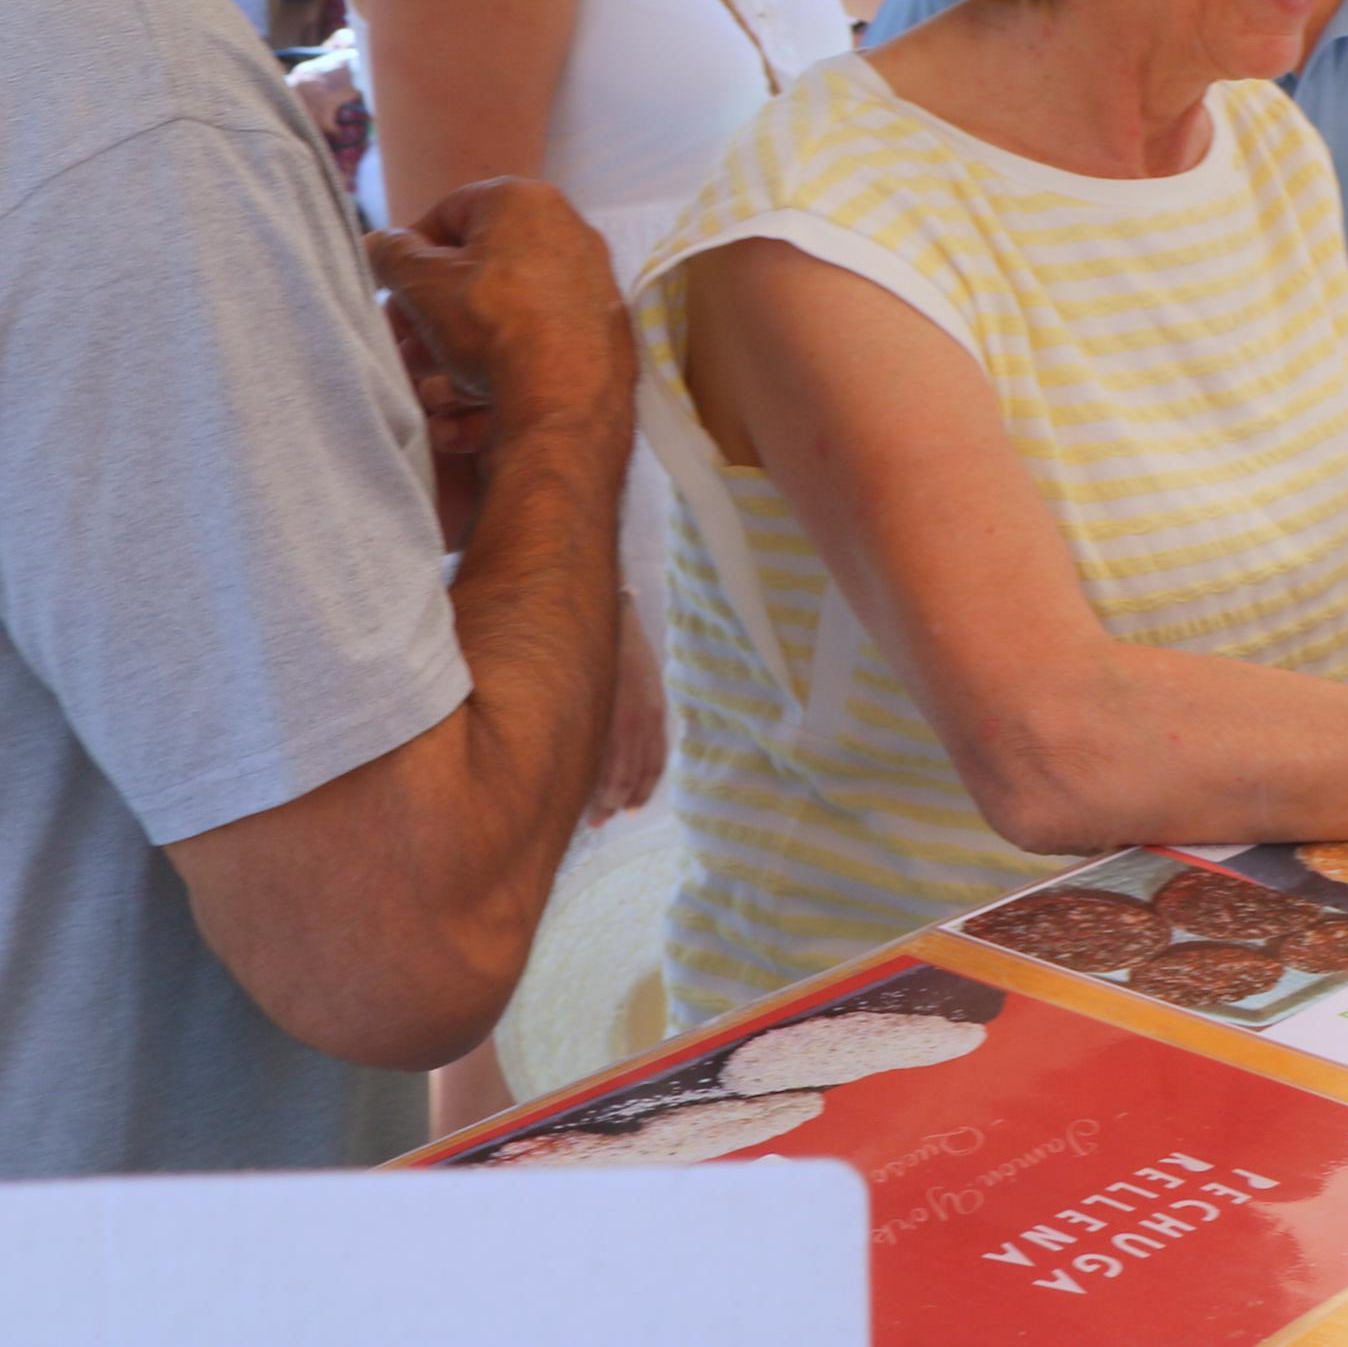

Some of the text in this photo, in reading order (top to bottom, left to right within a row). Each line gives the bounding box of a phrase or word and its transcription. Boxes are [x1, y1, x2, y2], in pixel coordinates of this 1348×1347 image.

[869, 1126, 985, 1184] Queso
[871, 1118, 1101, 1245] Jamón York
[980, 1151, 1215, 1268] RELLENA
[1031, 1168, 1281, 1297] PECHUGA
